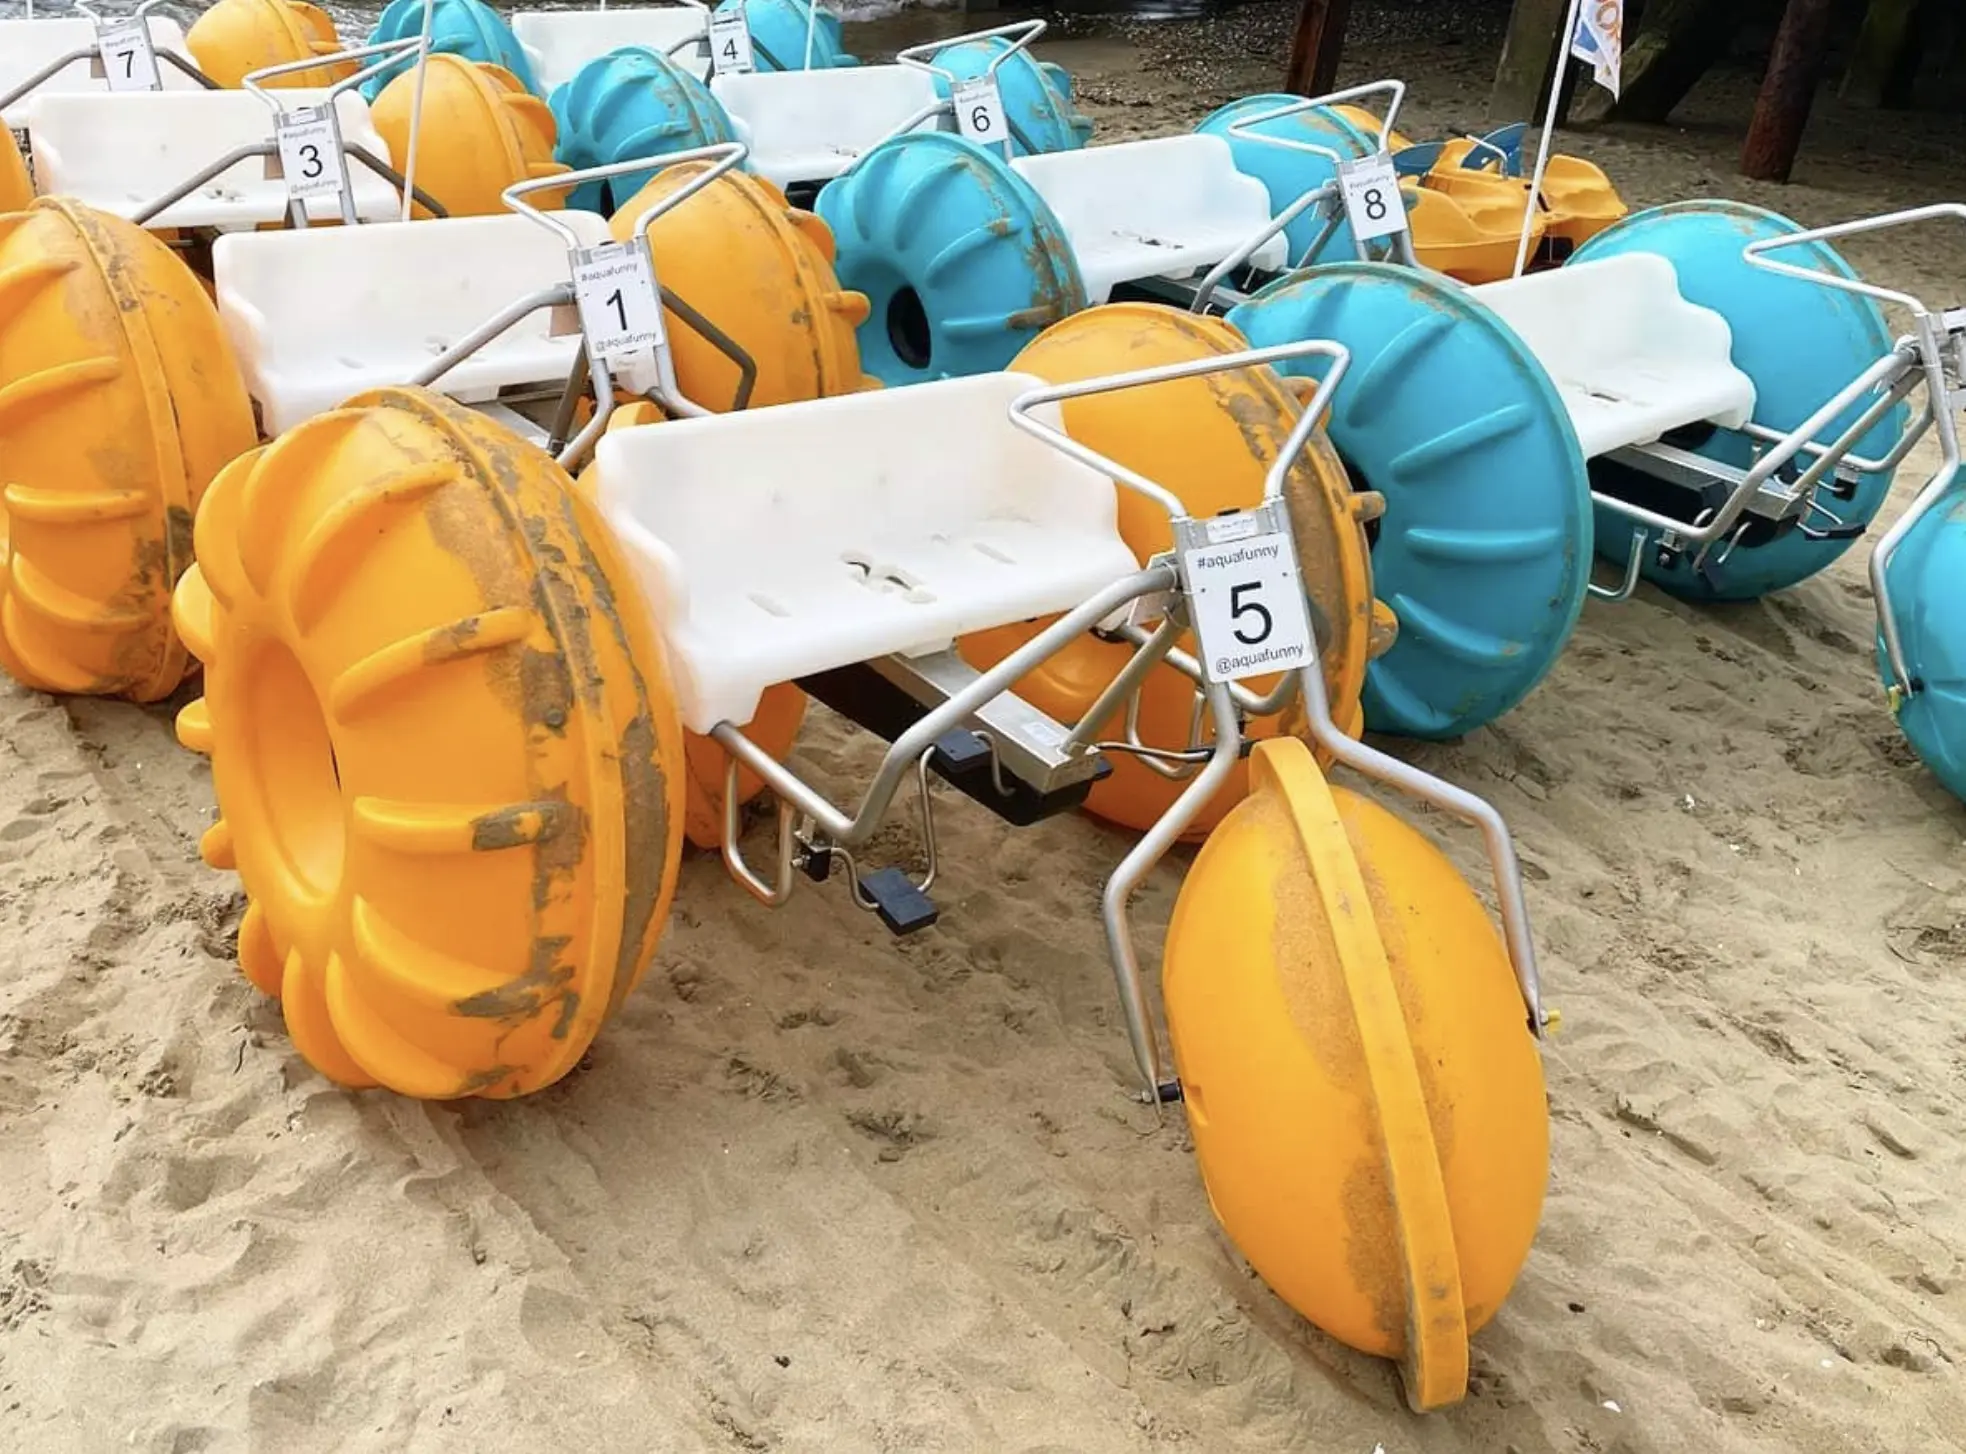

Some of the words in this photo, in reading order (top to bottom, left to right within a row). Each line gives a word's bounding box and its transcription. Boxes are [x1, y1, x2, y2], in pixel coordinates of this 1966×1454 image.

[116, 50, 134, 79] 7
[723, 38, 738, 60] 4
[972, 105, 990, 132] 6
[299, 144, 323, 178] 3
[1364, 188, 1386, 220] 8
[606, 288, 627, 331] 1
[1197, 545, 1279, 569] #aquafunny
[1231, 581, 1273, 645] 5
[1216, 643, 1304, 674] @aquafunny
